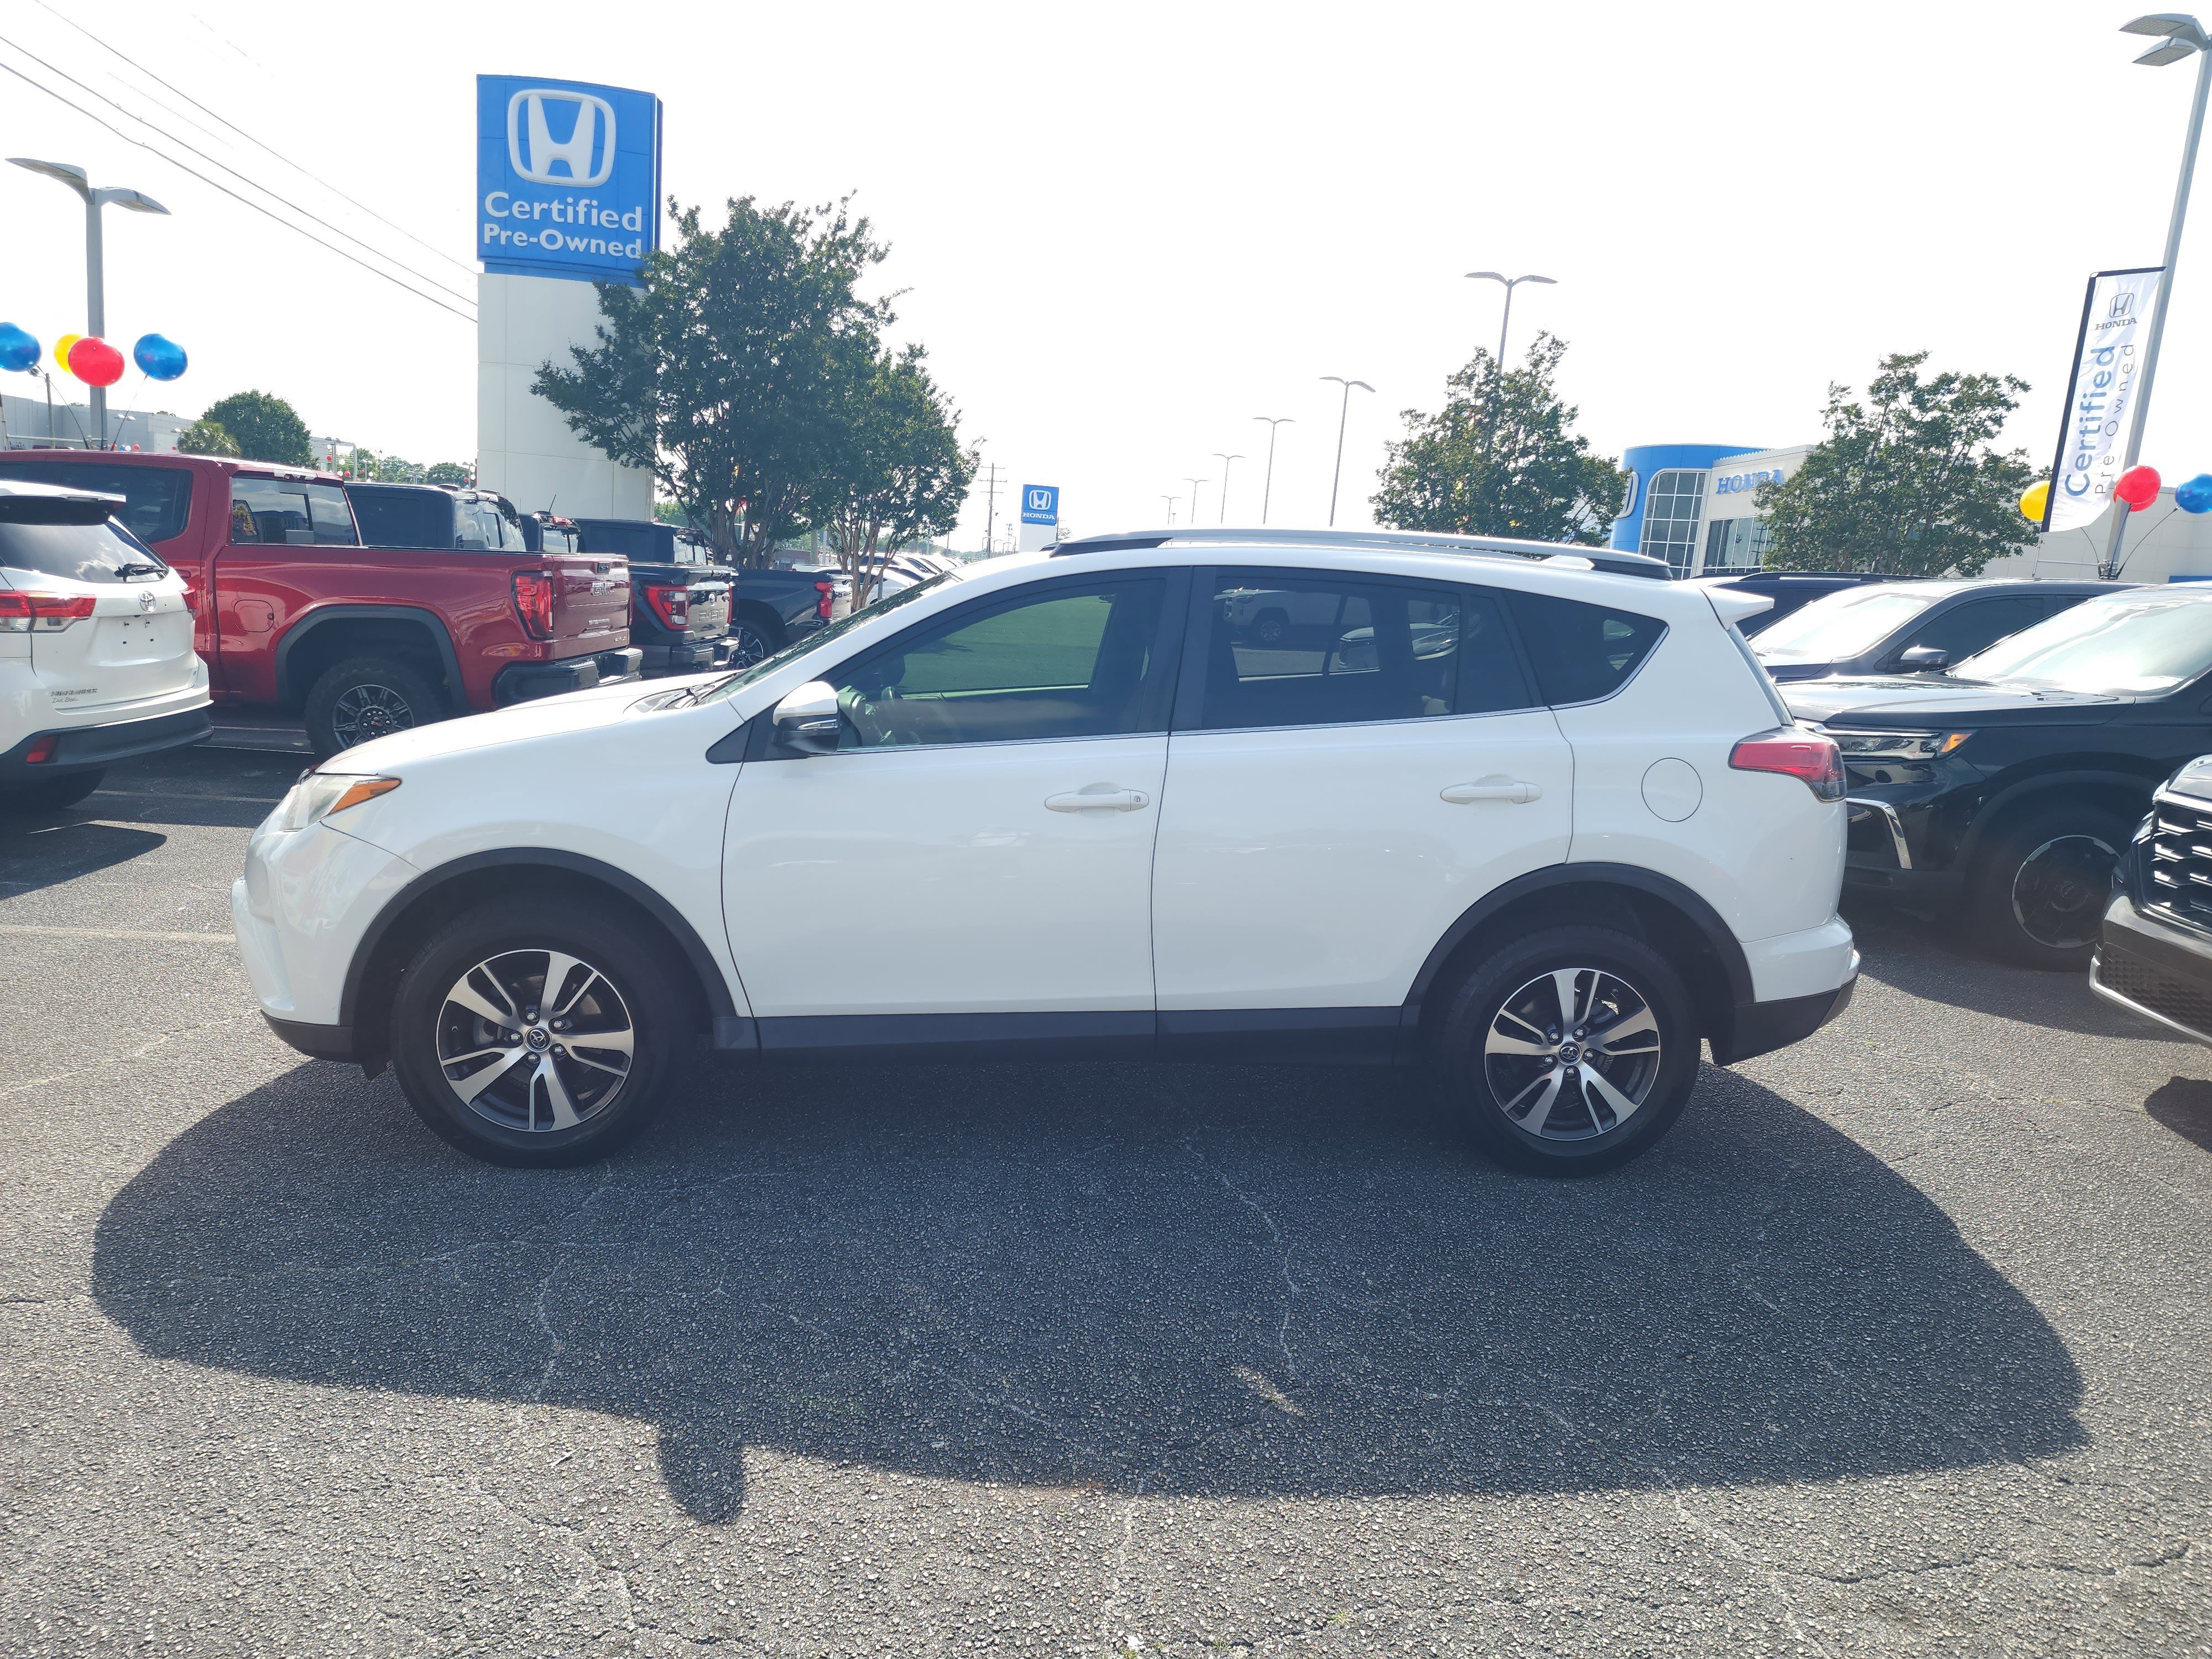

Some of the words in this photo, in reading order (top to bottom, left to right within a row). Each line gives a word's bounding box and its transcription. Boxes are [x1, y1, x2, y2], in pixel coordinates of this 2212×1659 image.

[484, 191, 643, 232] Certified
[484, 223, 642, 259] Pre-Owned
[2094, 317, 2138, 331] HONDA
[2065, 346, 2115, 497] Certified
[2095, 345, 2135, 494] Pre-Owned
[1716, 469, 1784, 494] HONDA
[590, 581, 615, 597] GMC
[698, 608, 724, 622] F-150
